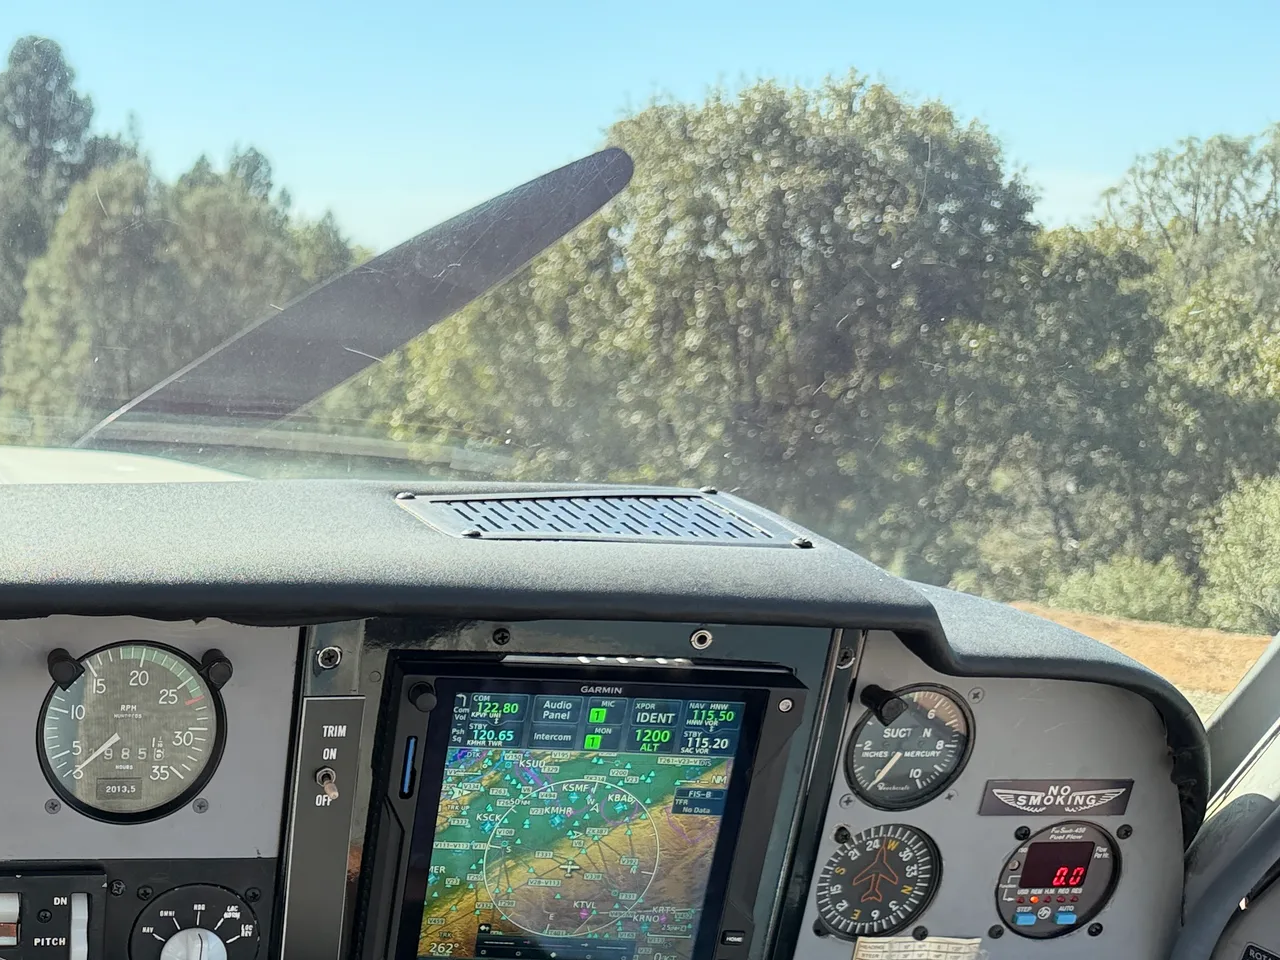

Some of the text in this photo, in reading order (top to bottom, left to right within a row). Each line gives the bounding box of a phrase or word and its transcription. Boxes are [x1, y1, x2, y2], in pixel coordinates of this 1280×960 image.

[129, 671, 148, 686] 20
[93, 679, 106, 694] 15
[581, 686, 622, 694] GARMIN
[159, 689, 178, 704] 25
[477, 702, 518, 713] 122.80
[543, 701, 572, 709] Audio
[543, 711, 569, 719] Panel
[636, 713, 675, 723] IDENT
[693, 710, 734, 721] 115.50
[323, 726, 346, 737] TRIM
[472, 730, 514, 741] 120.65
[534, 733, 571, 741] Intercom
[635, 730, 670, 742] 1200
[172, 731, 193, 746] 30
[687, 738, 728, 749] 115.20
[323, 748, 337, 759] ON
[150, 766, 170, 780] 35
[909, 769, 921, 778] 10
[563, 784, 588, 792] KSMF
[1048, 786, 1071, 795] NO
[1017, 796, 1097, 805] SMOKING
[866, 839, 880, 851] 24
[1053, 867, 1084, 885] 0.0
[573, 901, 596, 909] KTVL
[34, 938, 66, 946] PITCH
